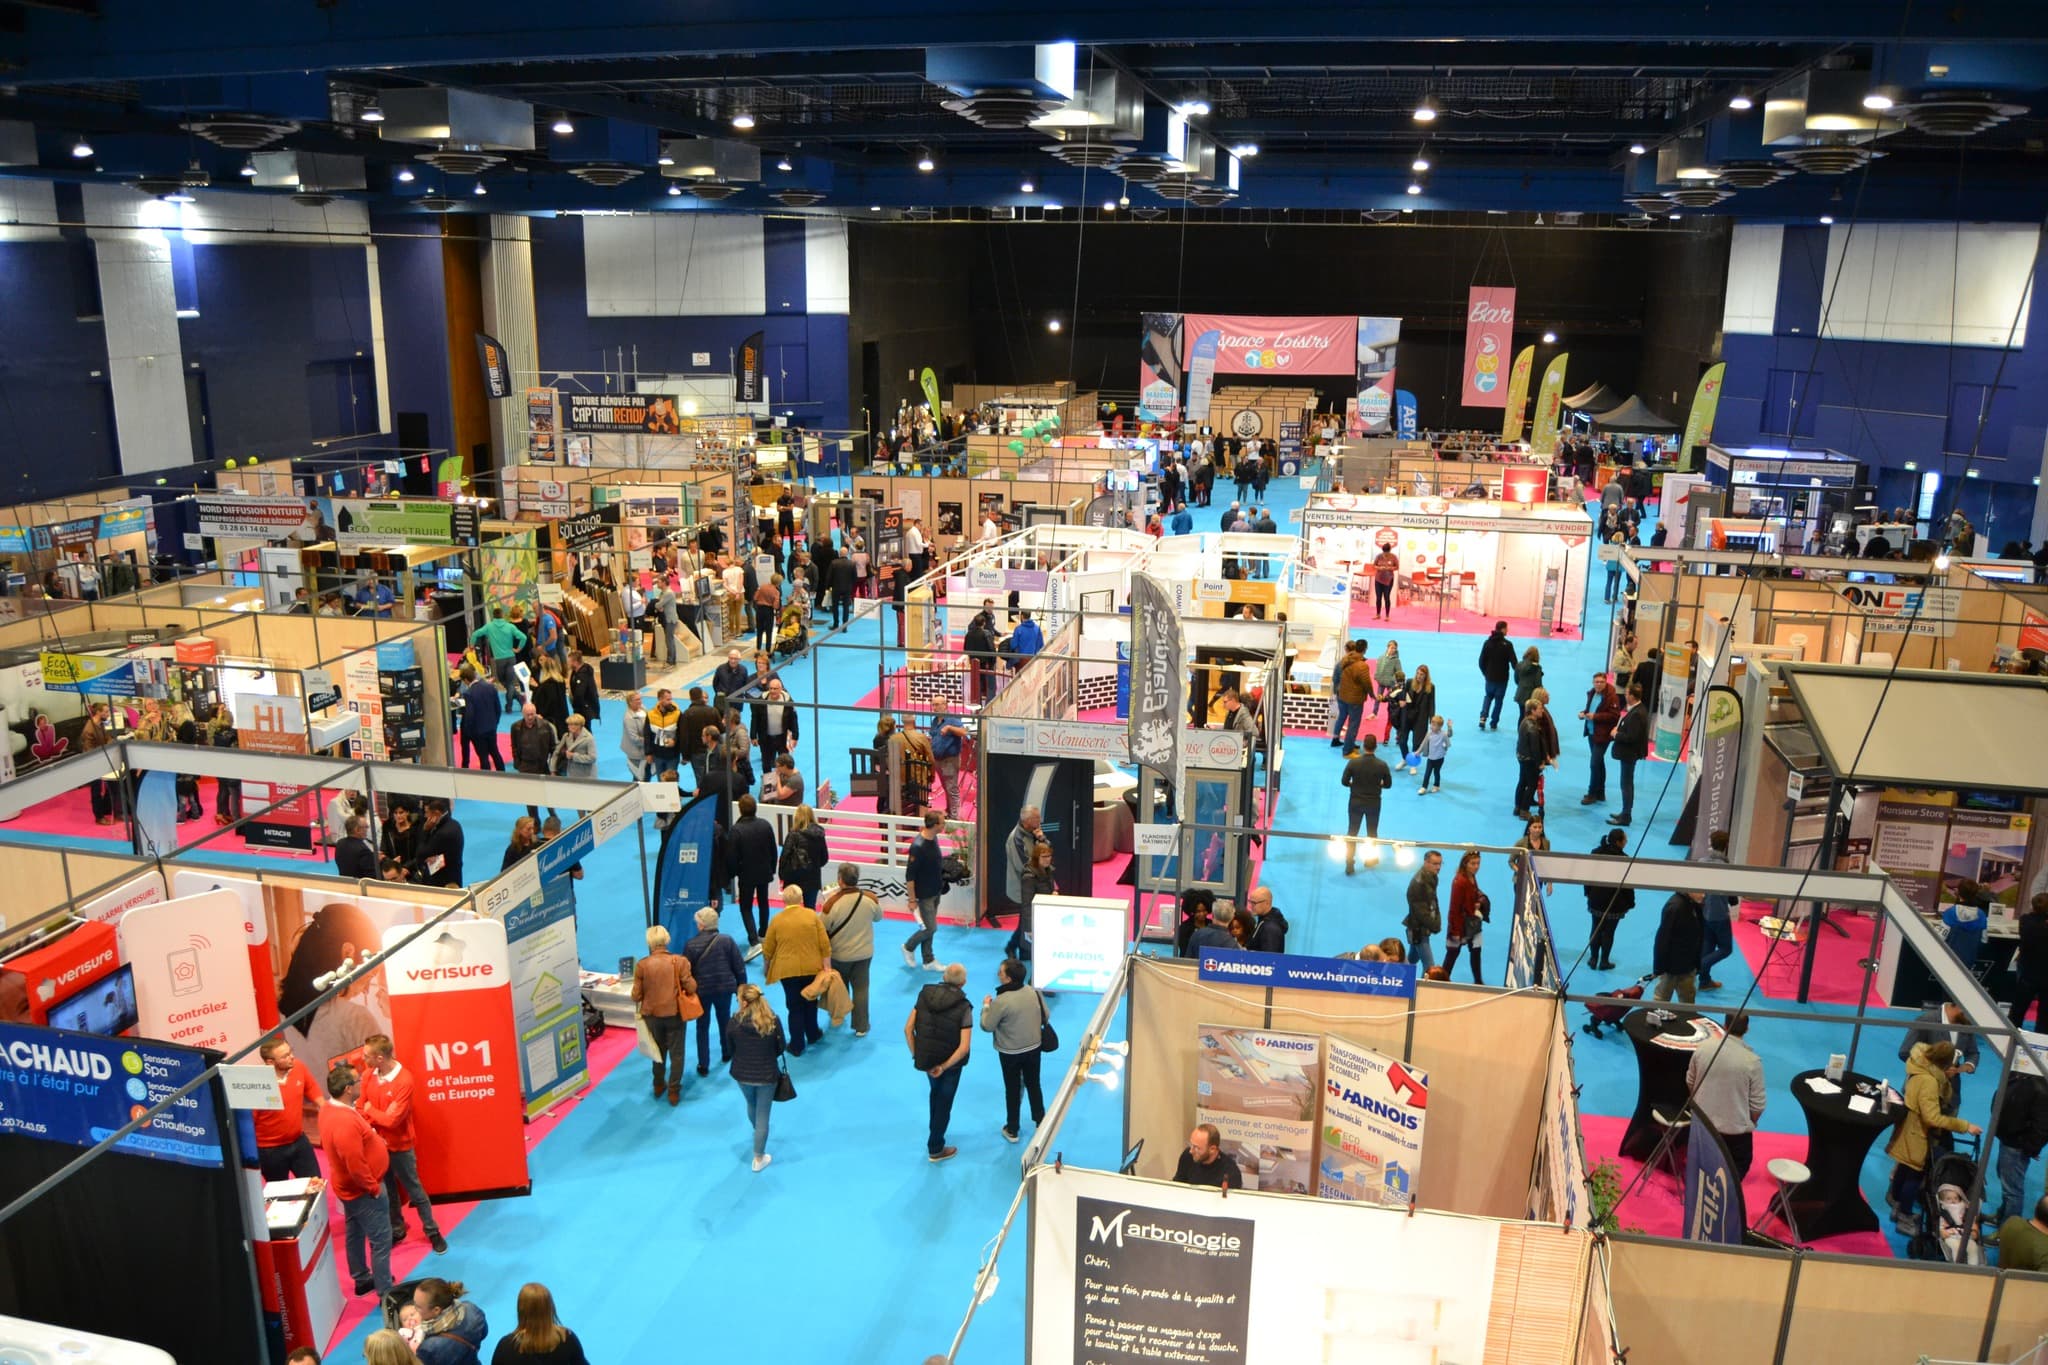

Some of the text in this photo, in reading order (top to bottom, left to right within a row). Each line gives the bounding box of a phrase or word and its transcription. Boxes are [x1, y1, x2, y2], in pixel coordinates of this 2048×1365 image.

[1469, 301, 1513, 324] Bar
[1217, 330, 1330, 351] space Loisirs
[572, 396, 600, 406] TOITURE
[632, 396, 646, 406] PAR
[200, 505, 304, 516] NORD DIFFUSION TOITURE
[542, 504, 568, 515] STR
[378, 525, 448, 536] CONSTRUIRE
[559, 514, 602, 540] SOL COLOR
[1403, 517, 1440, 525] MAISONS
[1554, 524, 1588, 532] VENDRE
[978, 571, 998, 579] Point
[1203, 583, 1223, 591] Point
[47, 655, 67, 669] Eco
[1037, 728, 1112, 749] Menuiserie
[1880, 806, 1945, 819] Monsieur Store
[1956, 813, 2008, 825] Monsieur Store
[600, 812, 619, 831] S3D
[263, 828, 292, 838] HITACHI
[487, 887, 510, 911] S3D
[56, 949, 114, 986] verisure
[406, 963, 494, 982] verisure
[1217, 960, 1273, 977] HARNOIS
[1288, 968, 1404, 988] www.harnois.biz
[168, 1001, 228, 1024] Contrôlez
[171, 1024, 204, 1041] votre
[1266, 1039, 1314, 1051] HARNOIS
[143, 1053, 181, 1067] Sensation
[1330, 1043, 1385, 1073] TRANSFORMATION ET
[144, 1064, 169, 1078] Spa
[427, 1071, 495, 1088] de l'alarme
[1329, 1062, 1361, 1082] DE COMBLES
[33, 1073, 70, 1092] l'état
[74, 1083, 100, 1096] pur
[231, 1081, 272, 1091] SECURITAS
[428, 1086, 496, 1103] en Europe
[1325, 1104, 1363, 1127] www.harnois.biz
[1342, 1088, 1418, 1130] HARNOIS
[152, 1118, 207, 1136] Chauffage
[1200, 1112, 1309, 1137] Transformer et aménager
[1228, 1127, 1280, 1141] vos combles
[1343, 1131, 1361, 1145] ECO
[1342, 1140, 1379, 1165] artisan
[1088, 1208, 1242, 1251] Marbrologie
[1183, 1246, 1207, 1256] Tailleur
[1084, 1278, 1237, 1308] Pour une fois, prends de la qualité et
[1084, 1292, 1121, 1305] qui dure.
[1084, 1313, 1222, 1342] Pense à passer au magasin d'expo
[1084, 1328, 1239, 1353] pour changer le receveur de la douche,
[1085, 1337, 1092, 1347] le
[1094, 1338, 1119, 1351] lavabo
[1121, 1343, 1130, 1353] et
[1132, 1344, 1140, 1354] la
[1142, 1345, 1162, 1358] table
